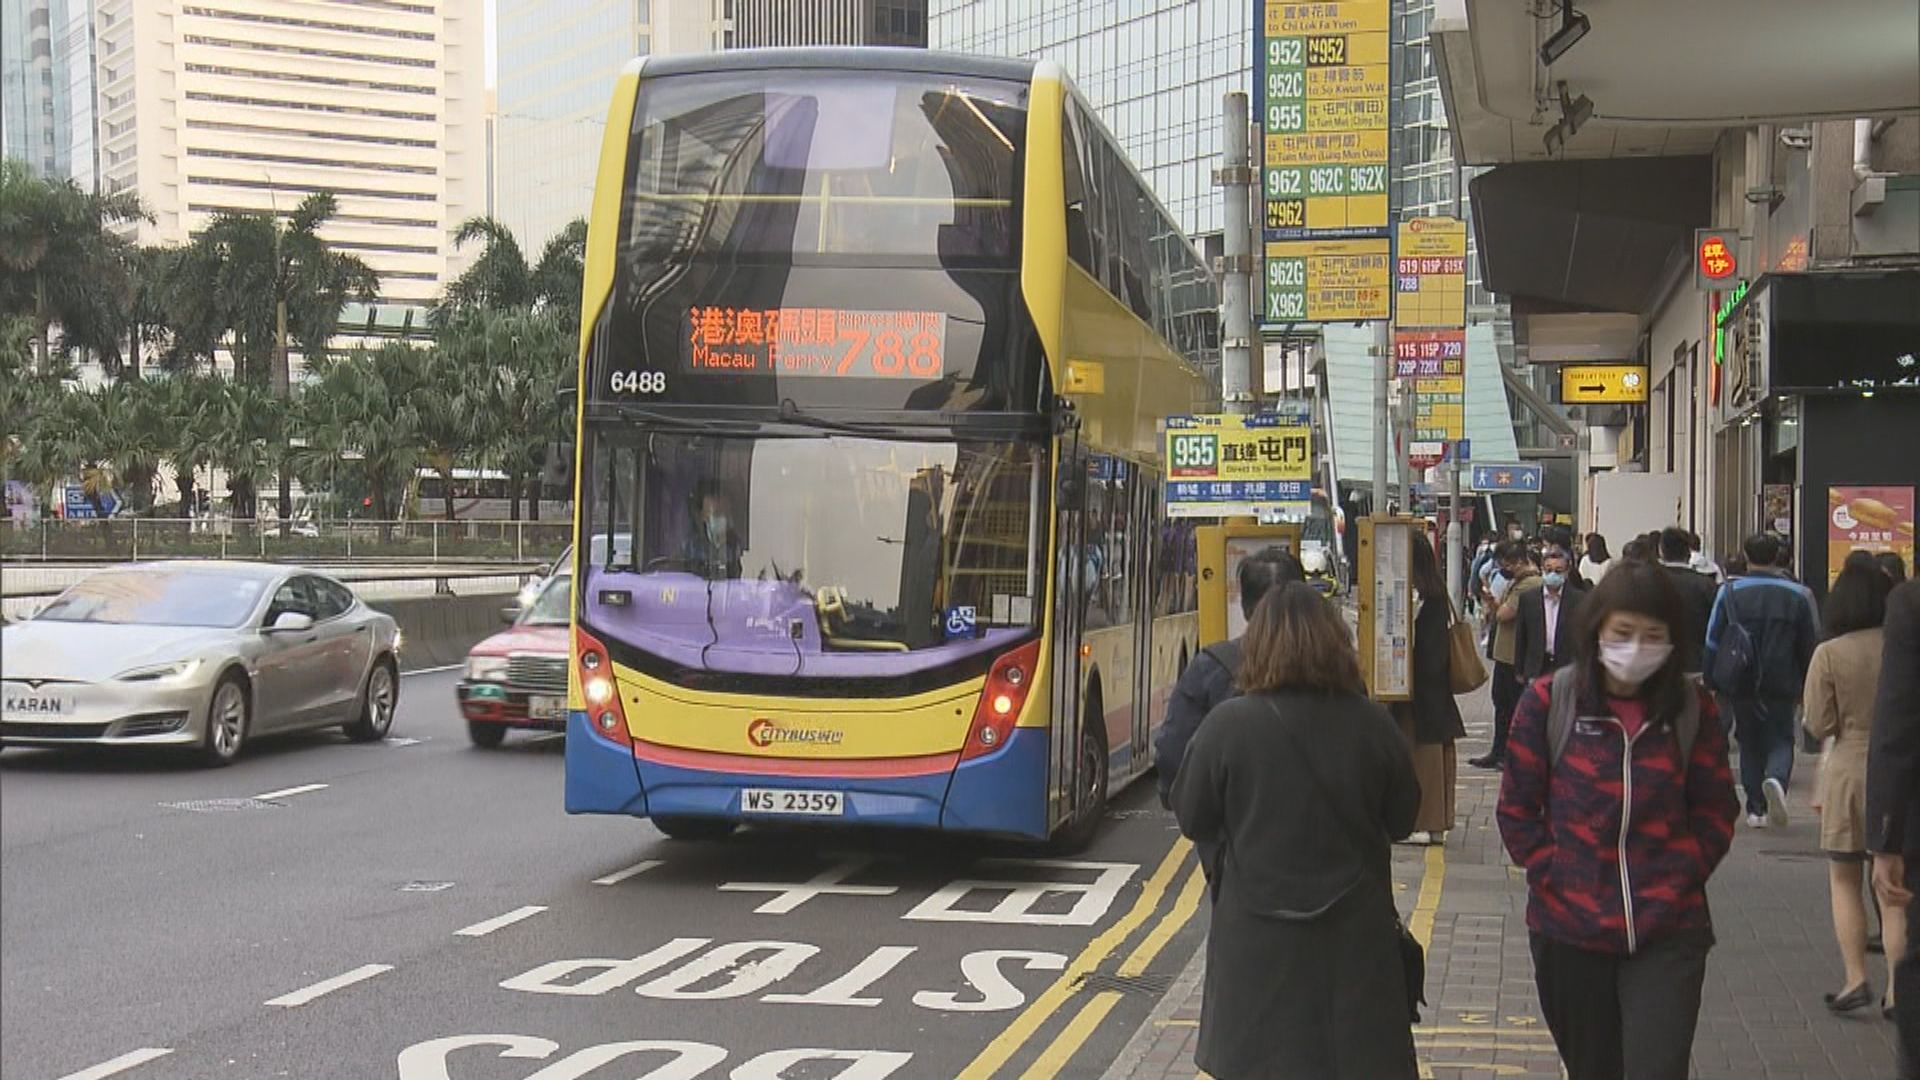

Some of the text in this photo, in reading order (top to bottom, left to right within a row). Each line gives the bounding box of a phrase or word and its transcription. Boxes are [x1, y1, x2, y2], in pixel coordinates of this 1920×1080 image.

[1269, 19, 1358, 31] to Chi Lok Fa Yuen
[1269, 40, 1301, 65] 952
[1269, 72, 1302, 97] 952C
[1365, 83, 1385, 92] Wat
[1269, 105, 1301, 130] 955
[1269, 166, 1385, 195] 962 962C 962X
[1270, 260, 1303, 286] 962G
[1399, 258, 1418, 274] 619
[1399, 277, 1417, 291] 788
[1270, 292, 1304, 317] X962
[690, 306, 836, 346] 港澳碼頭
[693, 345, 834, 369] Macau Ferry
[837, 330, 941, 375] 788
[1399, 342, 1461, 357] 115 115P 720
[610, 371, 666, 393] 6488
[1175, 437, 1214, 466] 955
[1222, 436, 1306, 462] 直達屯門
[6, 698, 61, 712] KARAN
[761, 727, 818, 741] CITYBUS
[748, 792, 837, 811] WS 2359
